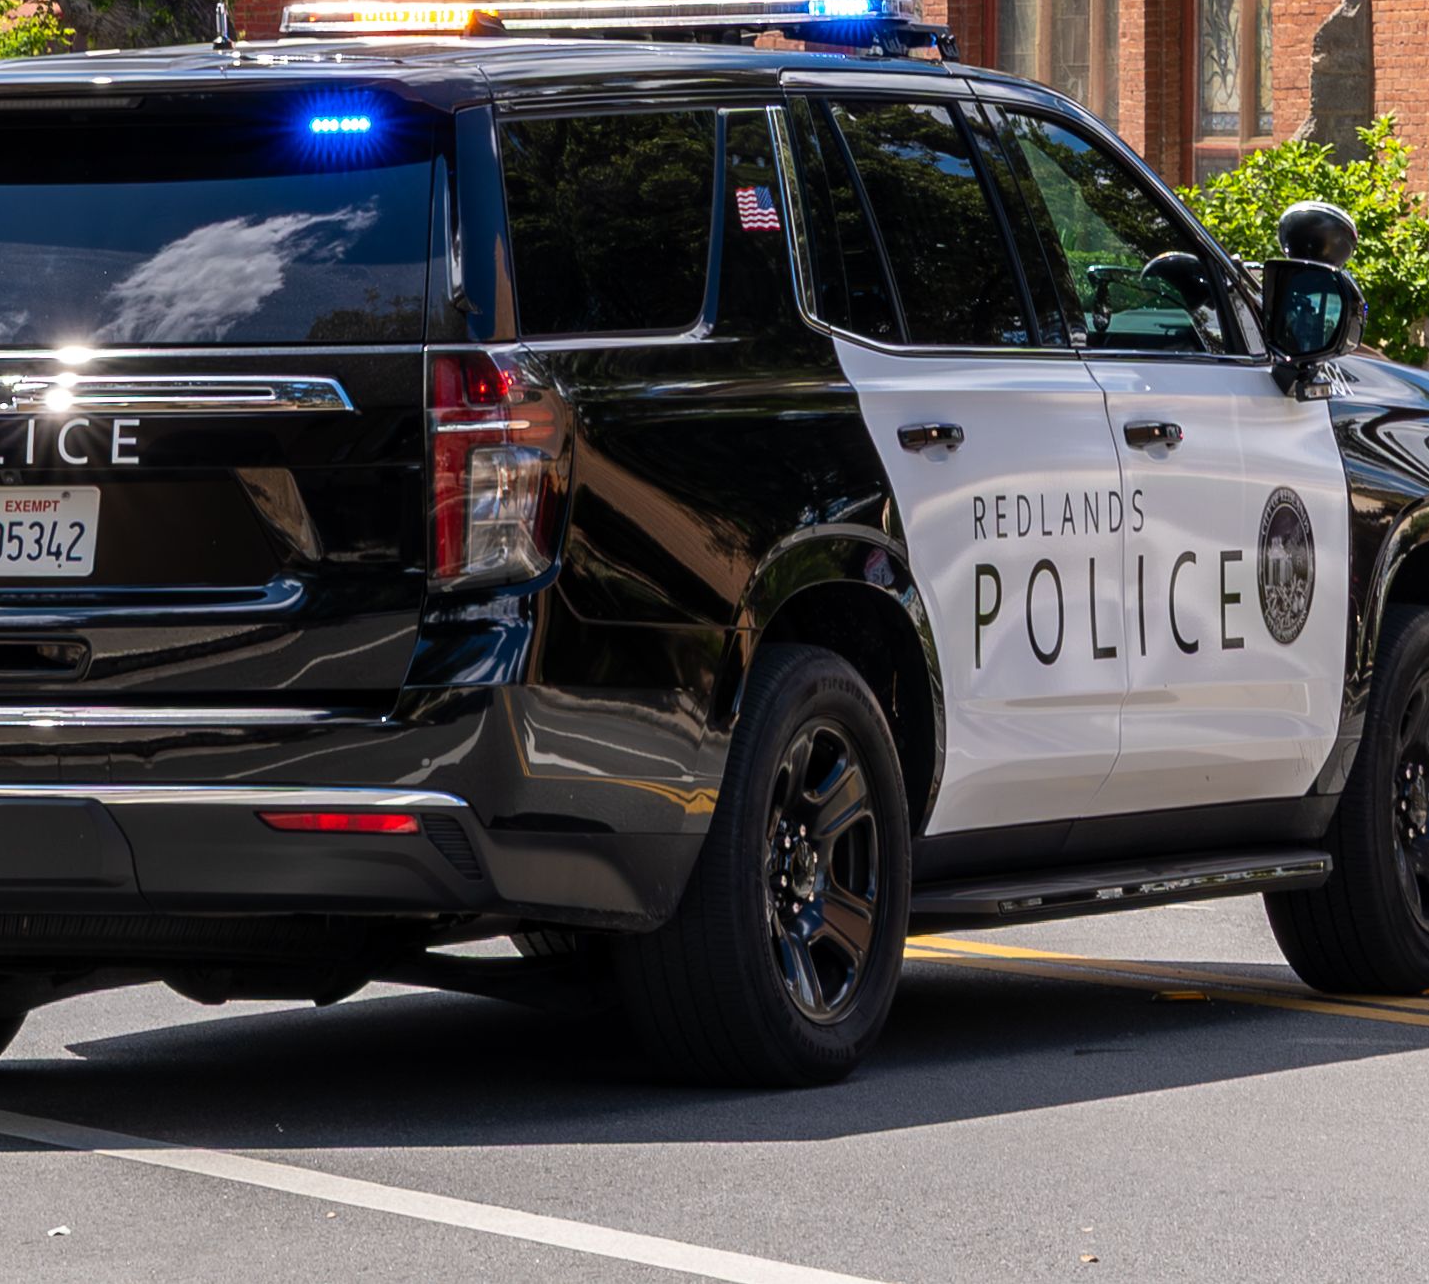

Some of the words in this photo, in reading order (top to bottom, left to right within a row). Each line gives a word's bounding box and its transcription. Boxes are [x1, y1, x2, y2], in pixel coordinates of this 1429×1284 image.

[5, 499, 61, 514] EXEMPT
[973, 489, 1145, 540] REDLANDS
[974, 549, 1245, 670] POLICE
